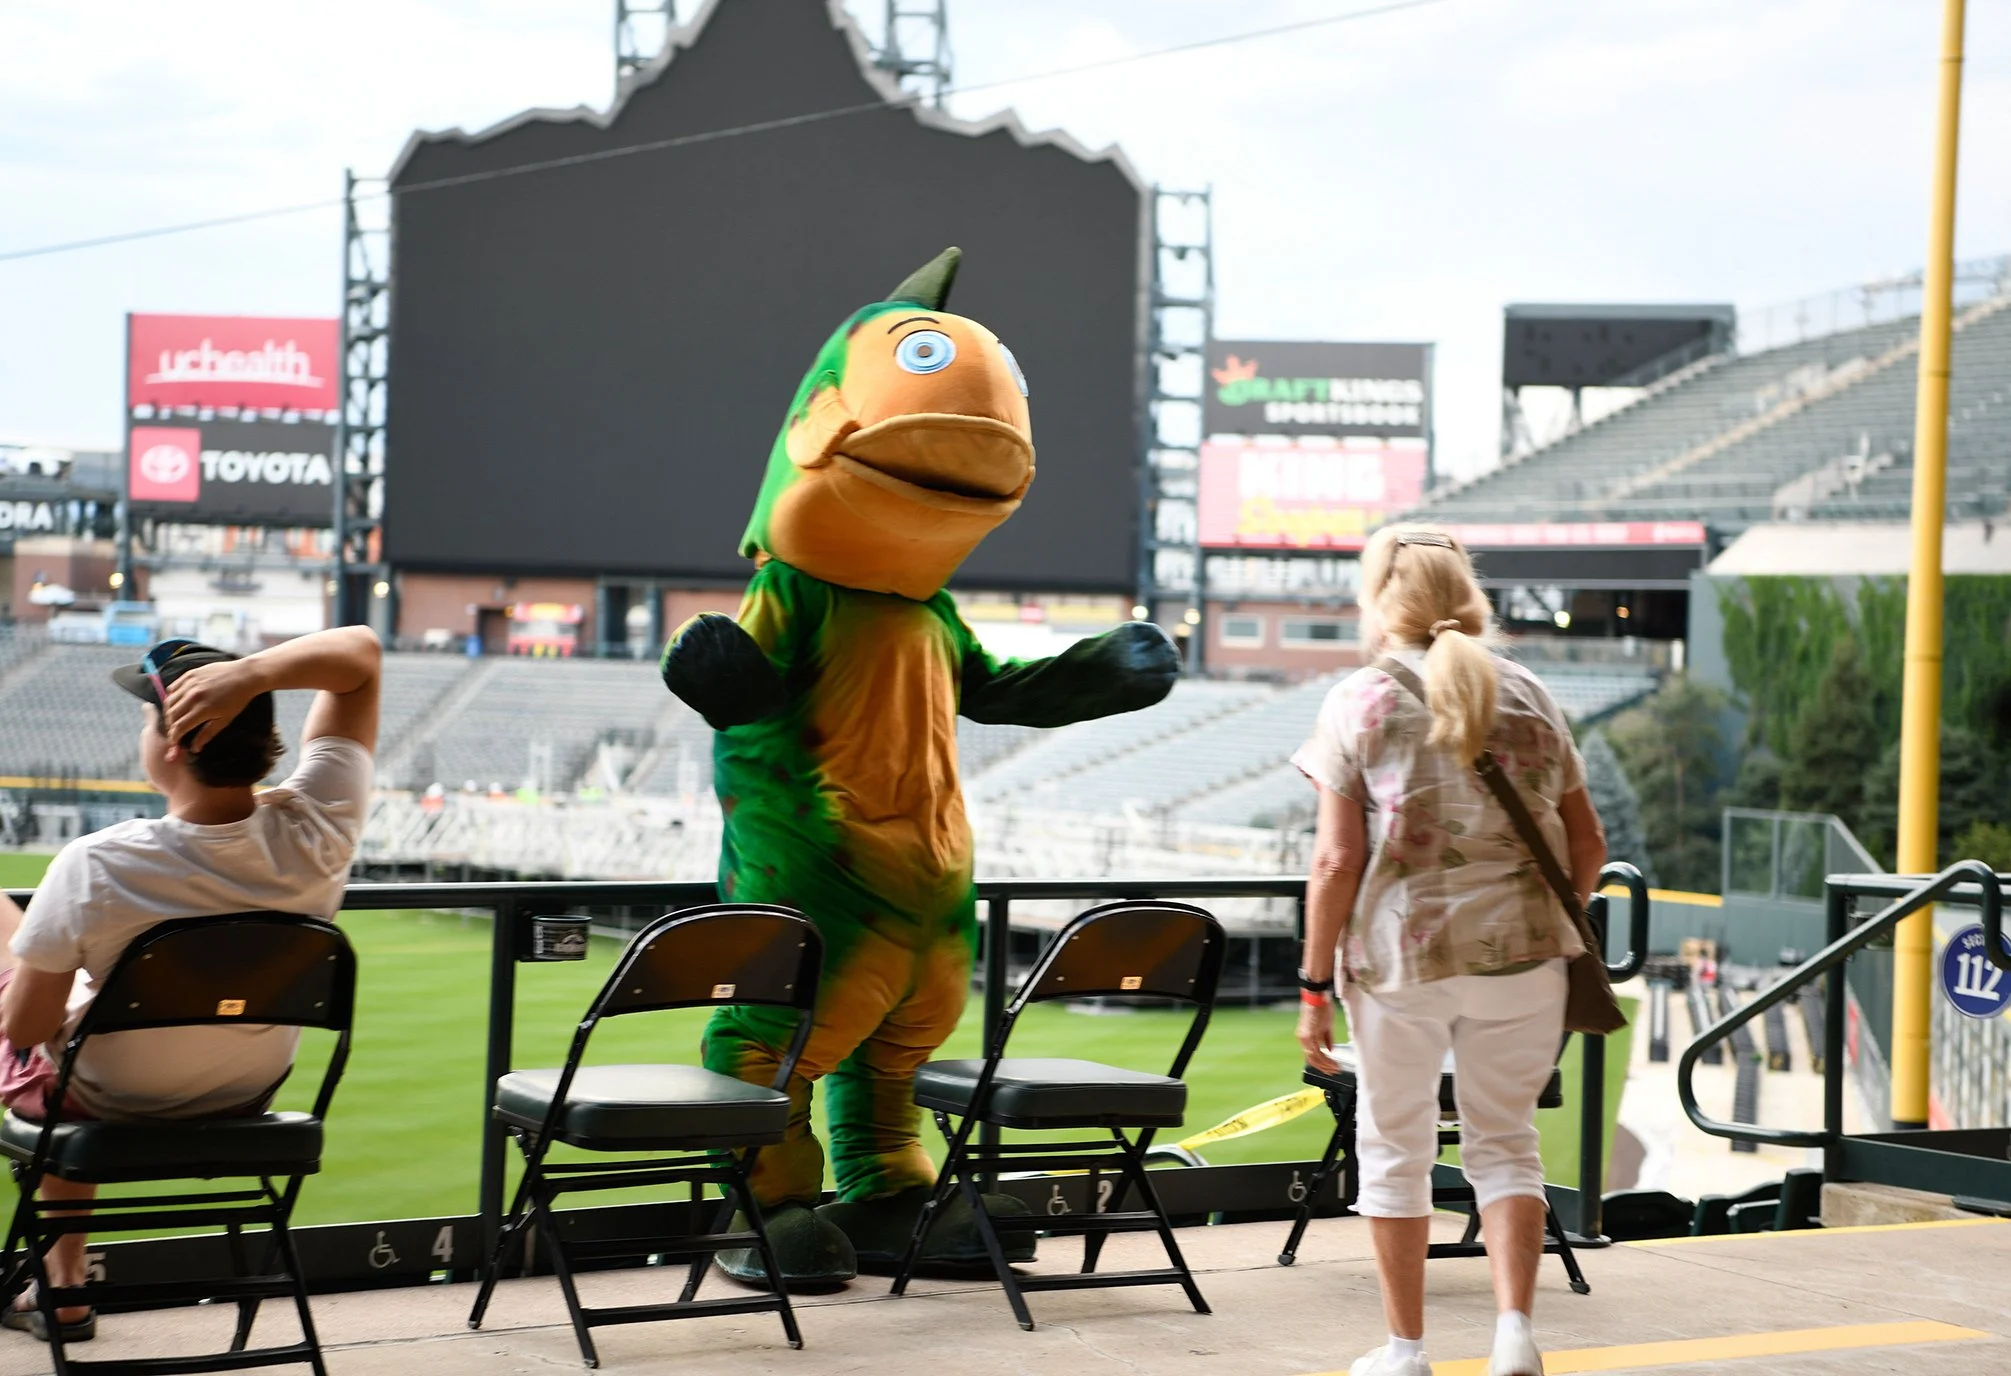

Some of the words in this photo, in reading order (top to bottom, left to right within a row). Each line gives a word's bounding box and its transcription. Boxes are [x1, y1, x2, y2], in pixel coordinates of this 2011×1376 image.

[158, 336, 313, 380] uchealth
[201, 450, 331, 485] TOYOTA
[1239, 451, 1384, 500] KING
[1953, 952, 2003, 1002] 112
[1096, 1180, 1113, 1213] 2
[431, 1225, 454, 1263] 4
